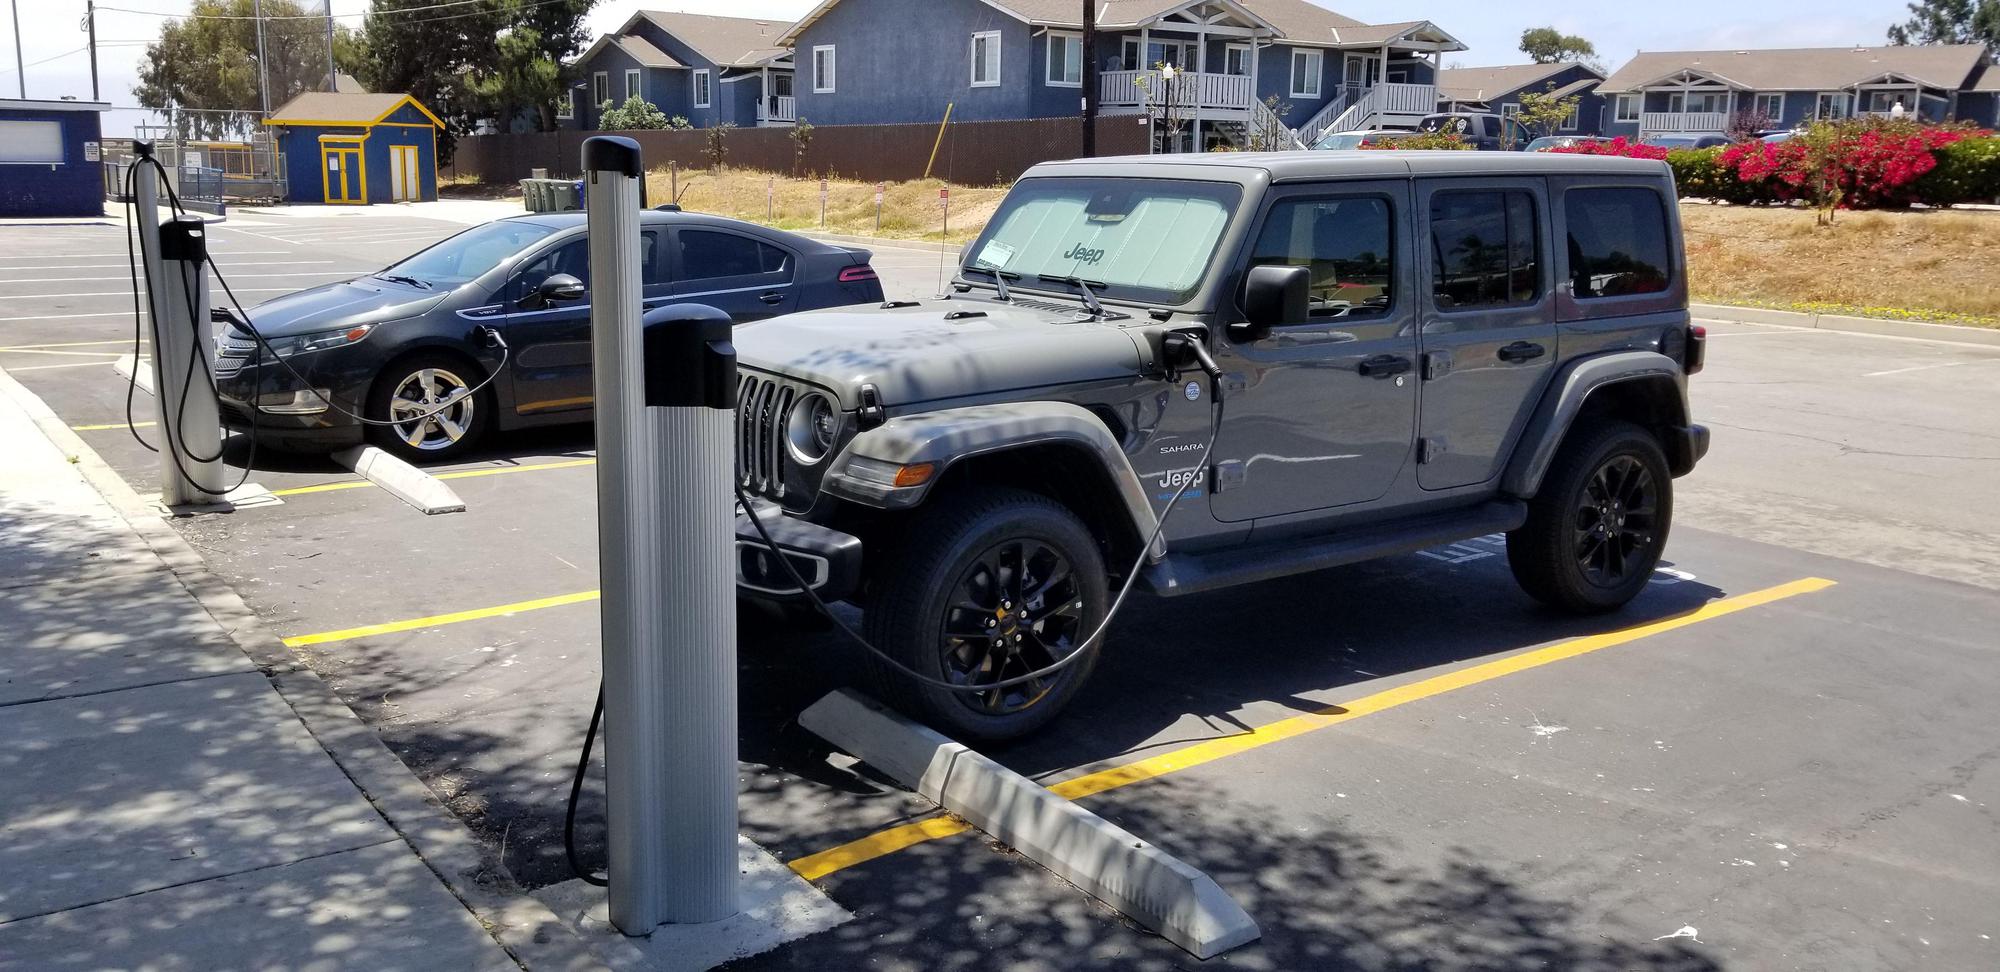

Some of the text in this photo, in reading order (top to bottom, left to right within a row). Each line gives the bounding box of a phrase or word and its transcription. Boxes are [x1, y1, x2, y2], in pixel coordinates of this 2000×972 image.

[1063, 242, 1105, 266] Jeep
[1160, 443, 1204, 454] SAHARA
[1159, 469, 1204, 488] Jeep
